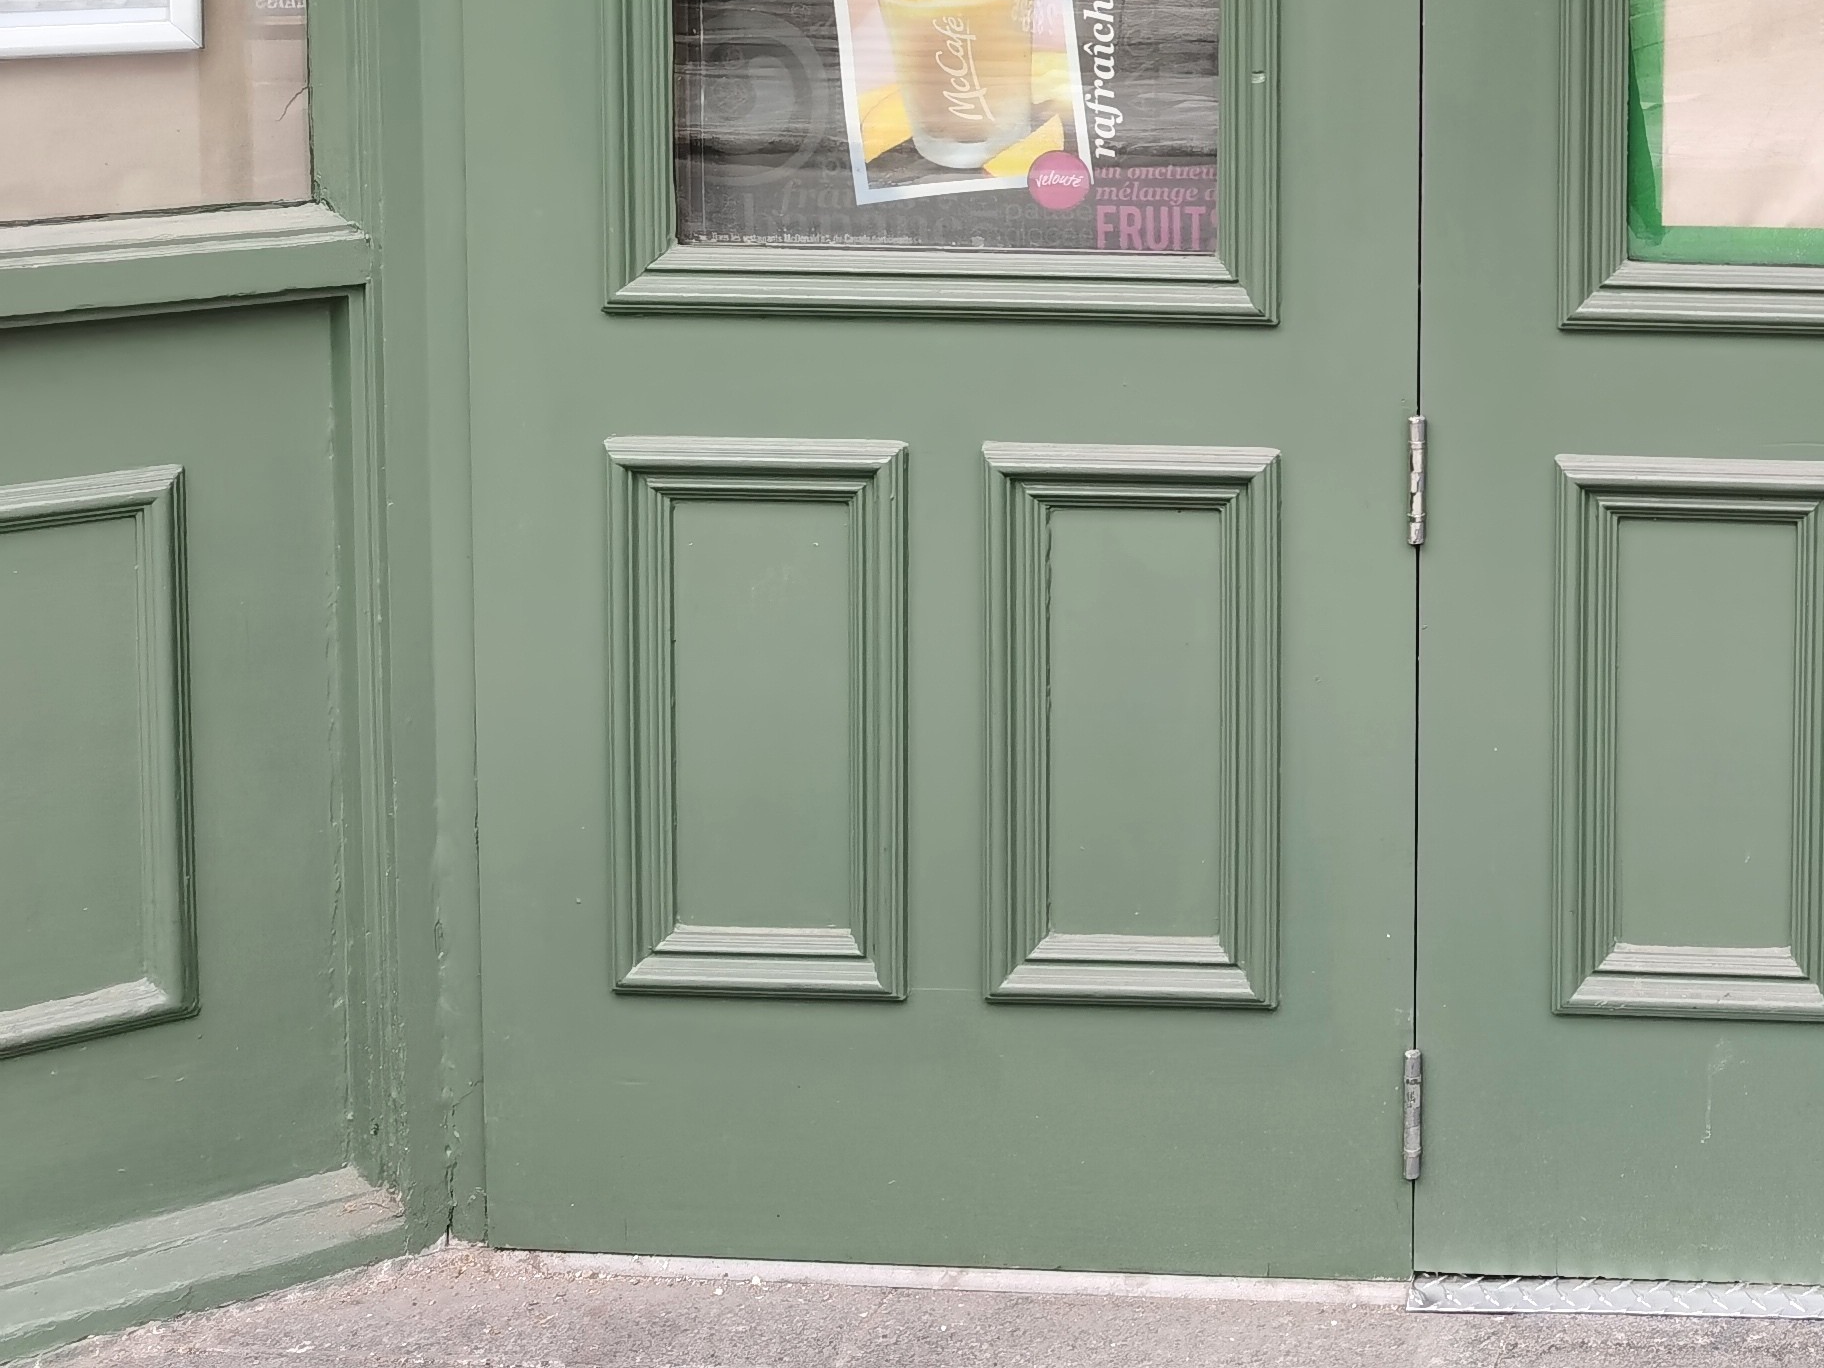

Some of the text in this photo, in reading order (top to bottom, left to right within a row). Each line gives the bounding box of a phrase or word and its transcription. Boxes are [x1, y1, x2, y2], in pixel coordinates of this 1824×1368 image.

[933, 16, 990, 121] McCafé
[1035, 170, 1084, 188] velouté
[1095, 181, 1199, 206] mélange
